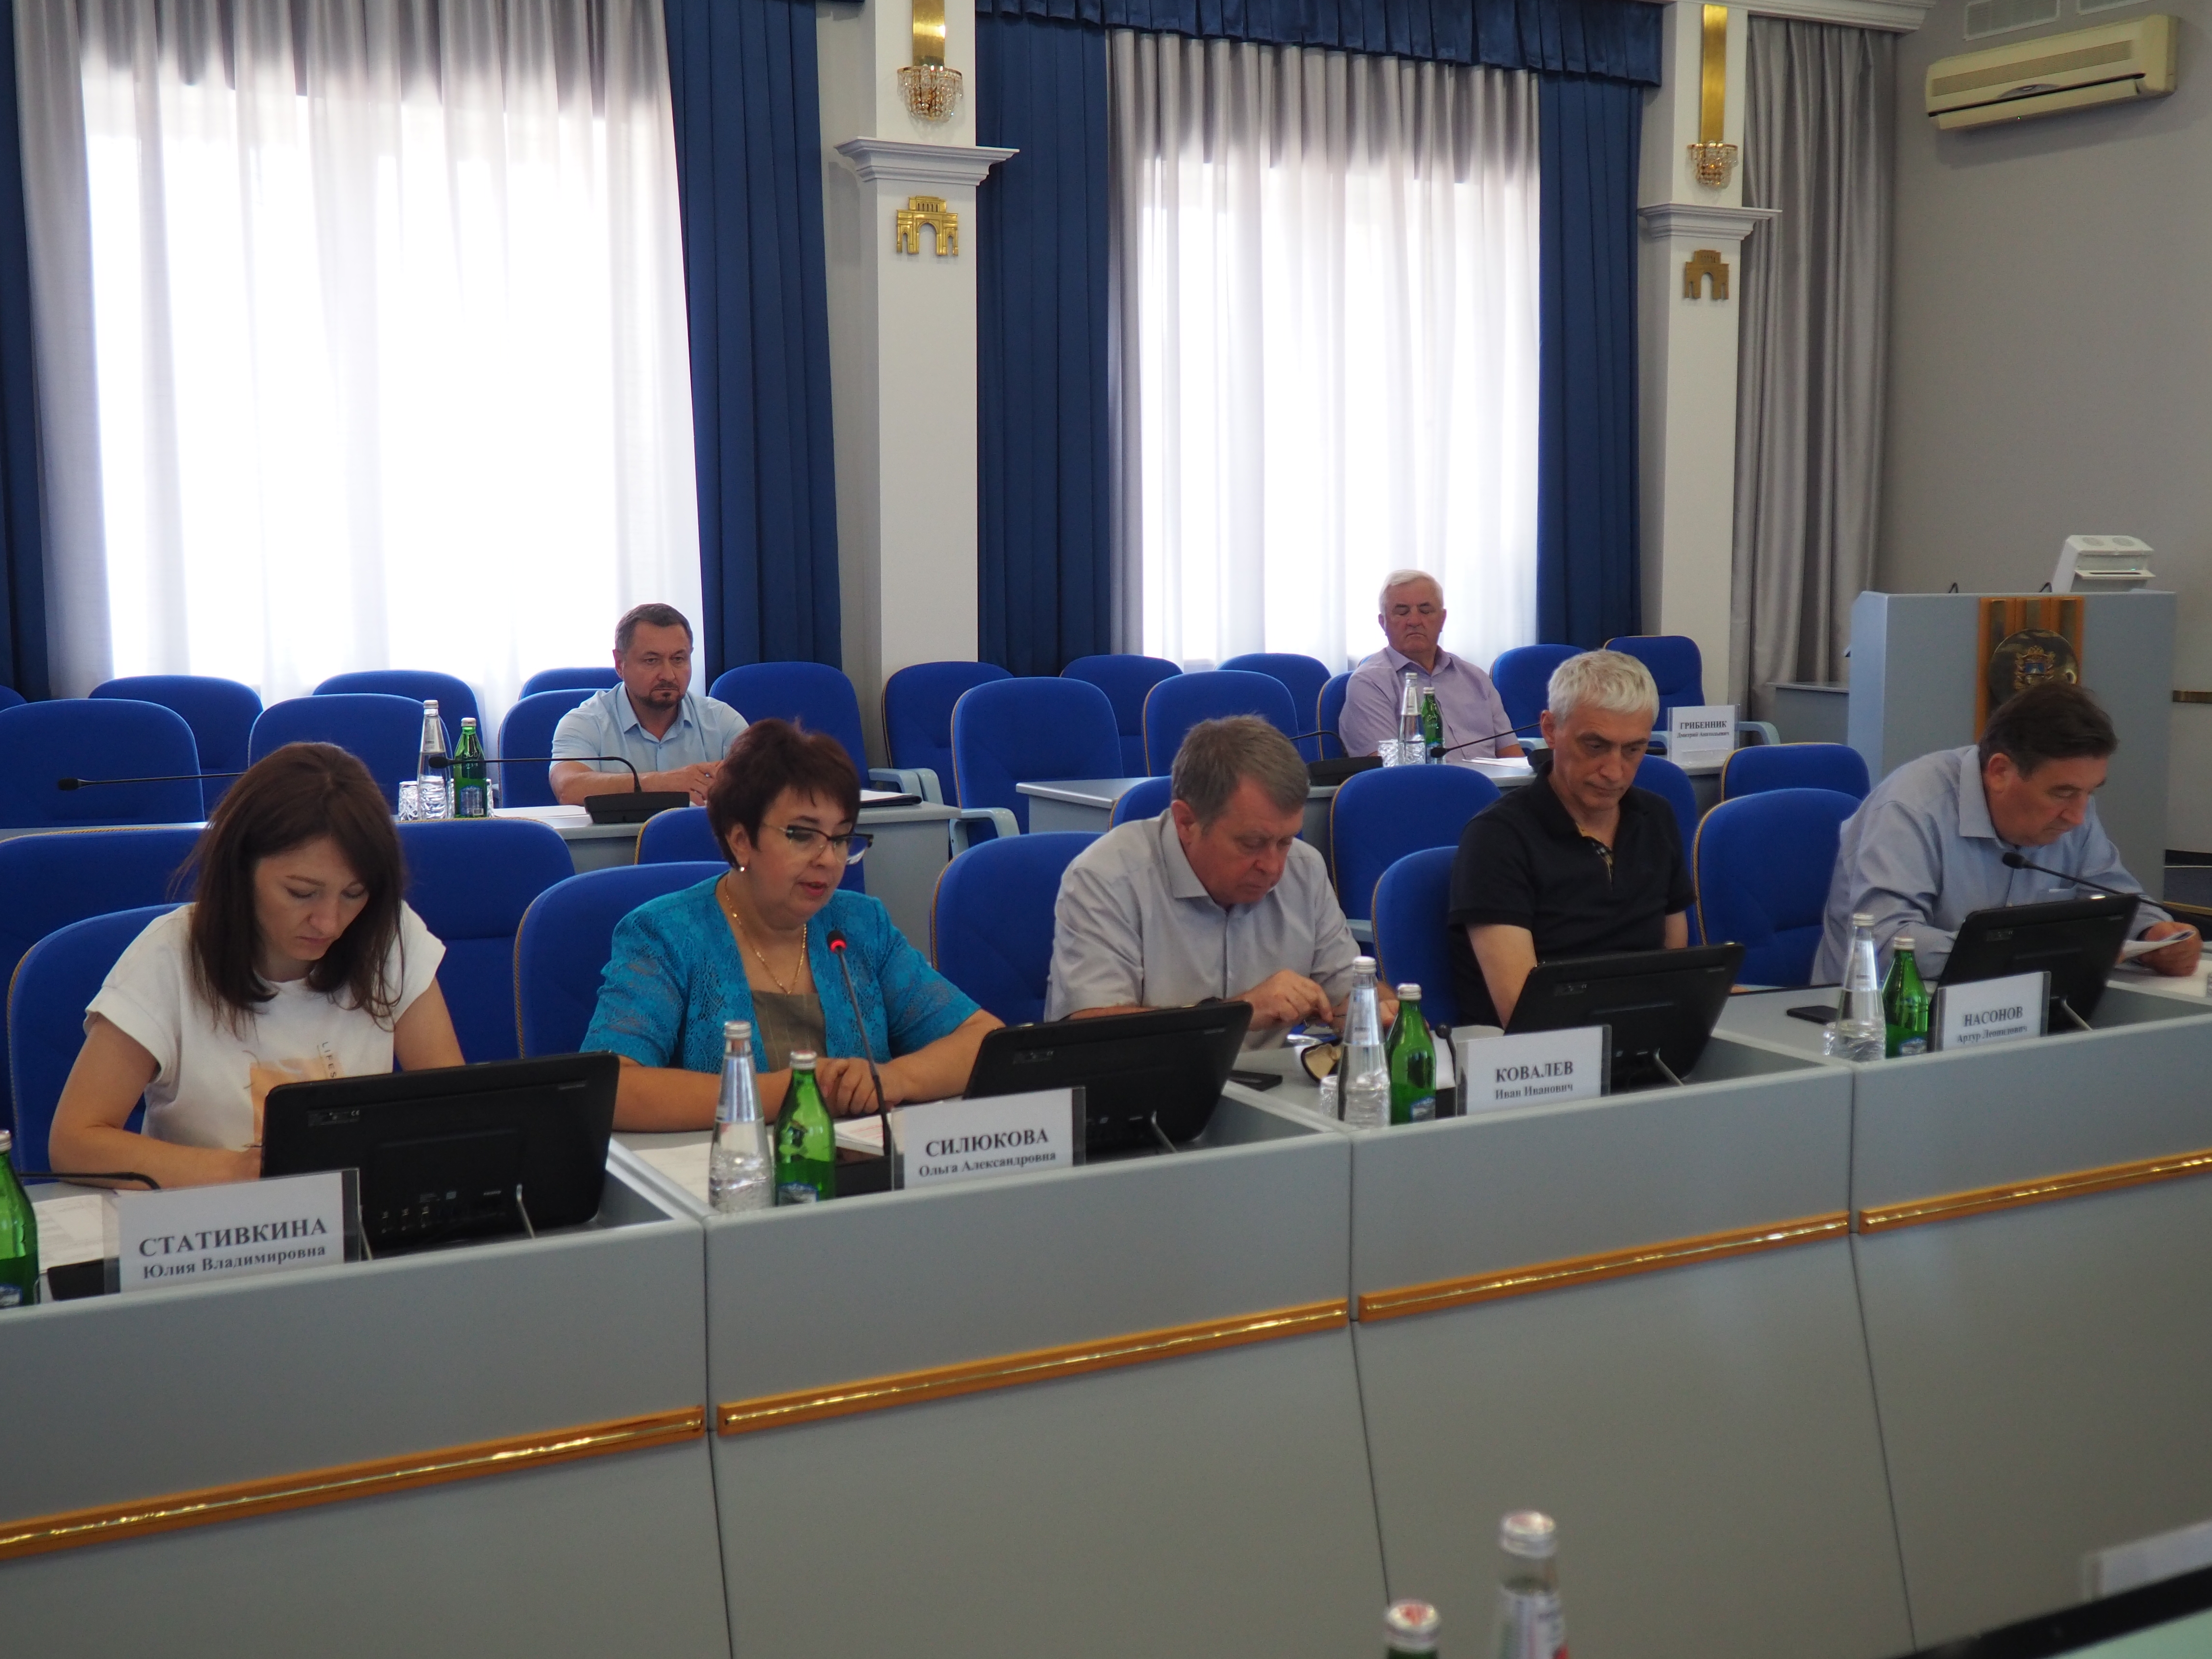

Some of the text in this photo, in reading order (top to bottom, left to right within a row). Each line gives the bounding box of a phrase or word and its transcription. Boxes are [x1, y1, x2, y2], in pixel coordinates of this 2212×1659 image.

[1680, 721, 1727, 729] ГРИБЕННИК
[1963, 1006, 2023, 1027] НАСОНОВ
[1957, 1033, 1981, 1044] Артур
[1495, 1061, 1574, 1083] КОВАЛЕВ
[1495, 1084, 1573, 1100] Иван Иванович
[926, 1127, 1049, 1157] СИЛЮКОВА
[919, 1152, 1056, 1178] Ольга Александровна
[139, 1217, 327, 1257] СТАТИВКИНА
[144, 1246, 326, 1280] Юлия Владимировна
